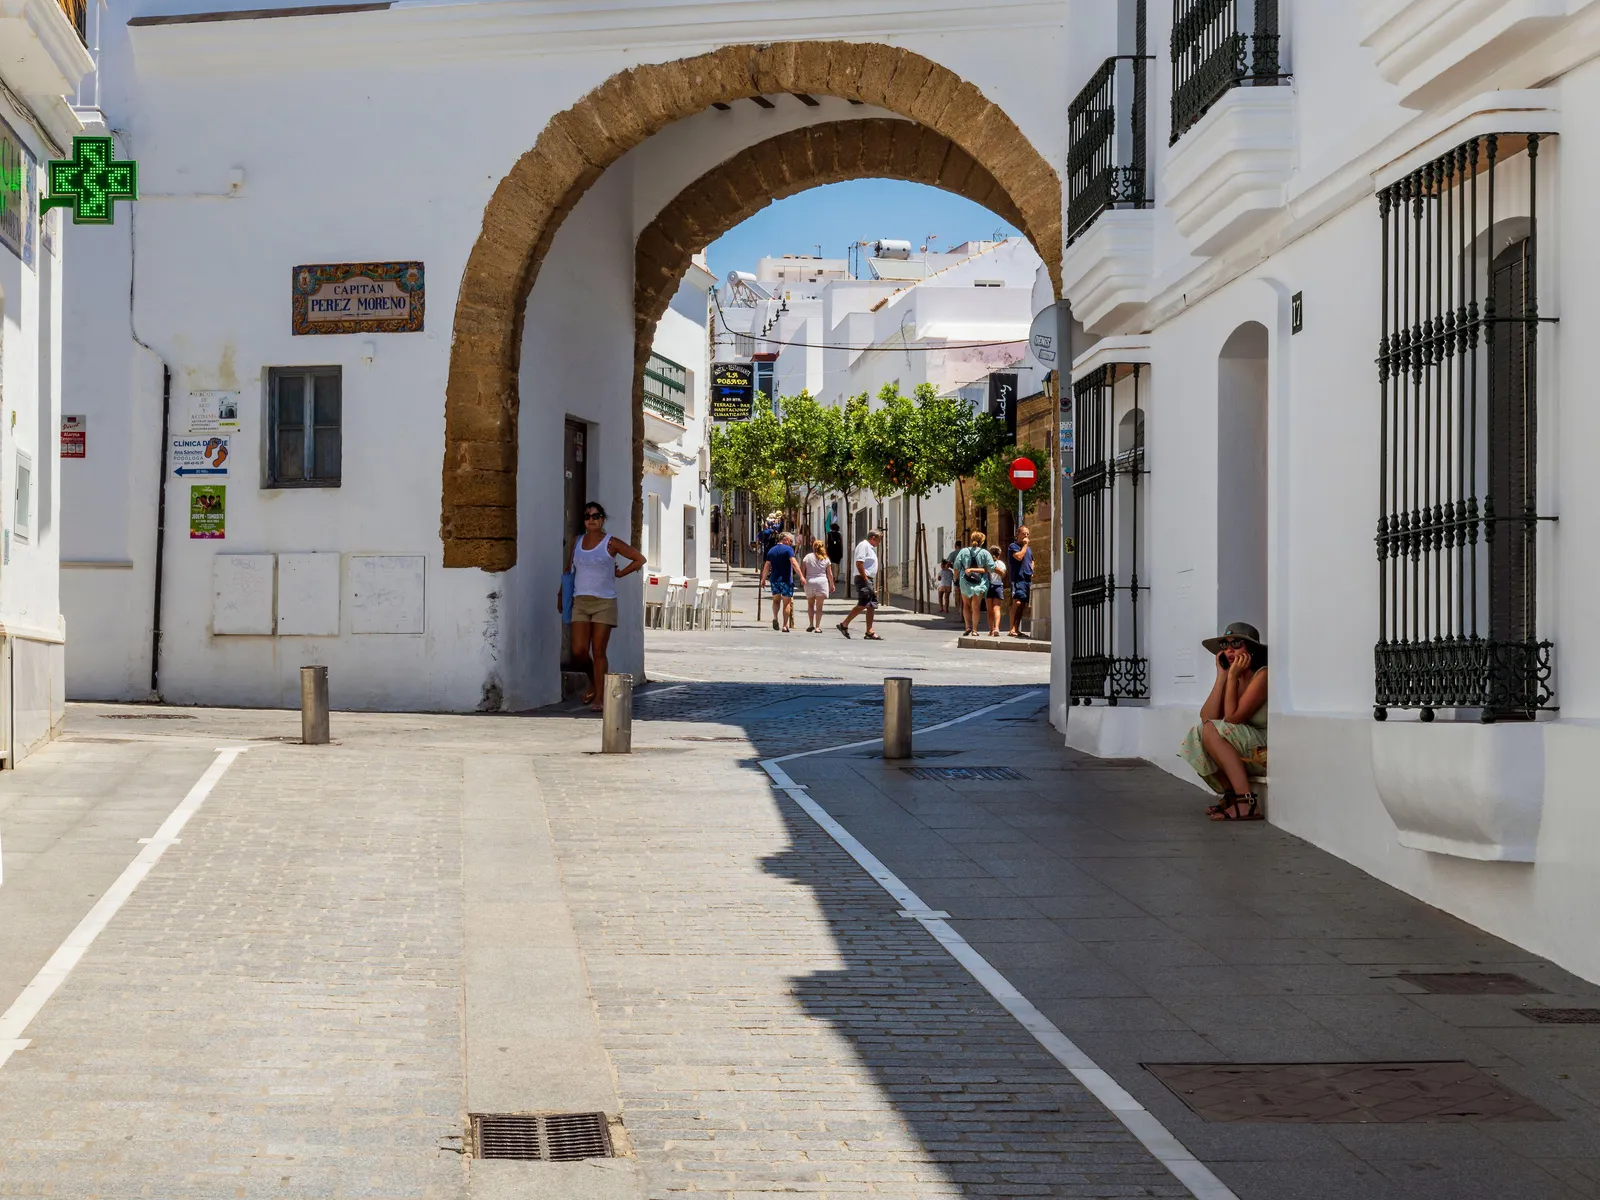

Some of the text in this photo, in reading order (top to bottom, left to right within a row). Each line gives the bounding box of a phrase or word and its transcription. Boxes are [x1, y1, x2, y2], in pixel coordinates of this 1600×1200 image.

[334, 284, 384, 295] CAPITAN
[311, 296, 406, 312] PEREZ MORENO
[1293, 299, 1300, 326] 17
[173, 439, 201, 447] CLÍNICA
